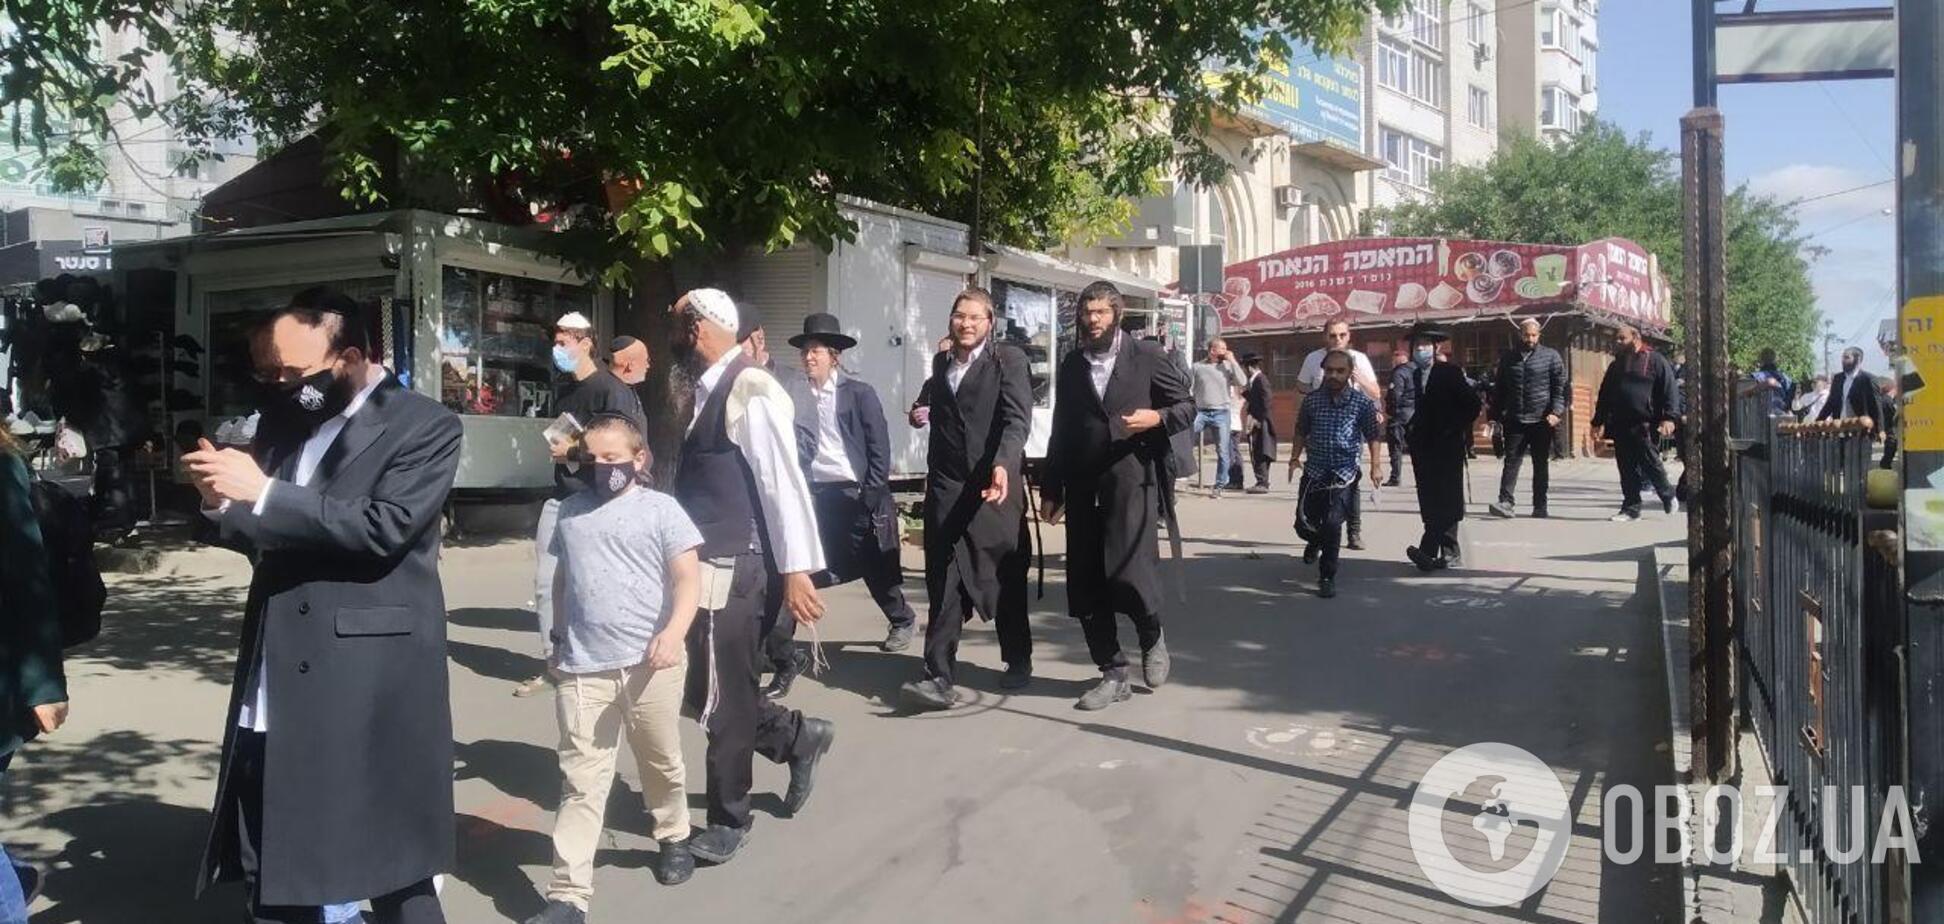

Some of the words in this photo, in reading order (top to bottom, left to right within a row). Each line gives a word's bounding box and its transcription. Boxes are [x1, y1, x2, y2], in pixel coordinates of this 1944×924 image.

[55, 256, 99, 270] סנטר
[1343, 244, 1434, 271] המאפה
[1258, 254, 1329, 283] הנאמן
[1295, 280, 1315, 290] 2016
[1319, 276, 1353, 288] בשנת
[1362, 273, 1391, 284] נוסד
[1907, 317, 1933, 333] זה
